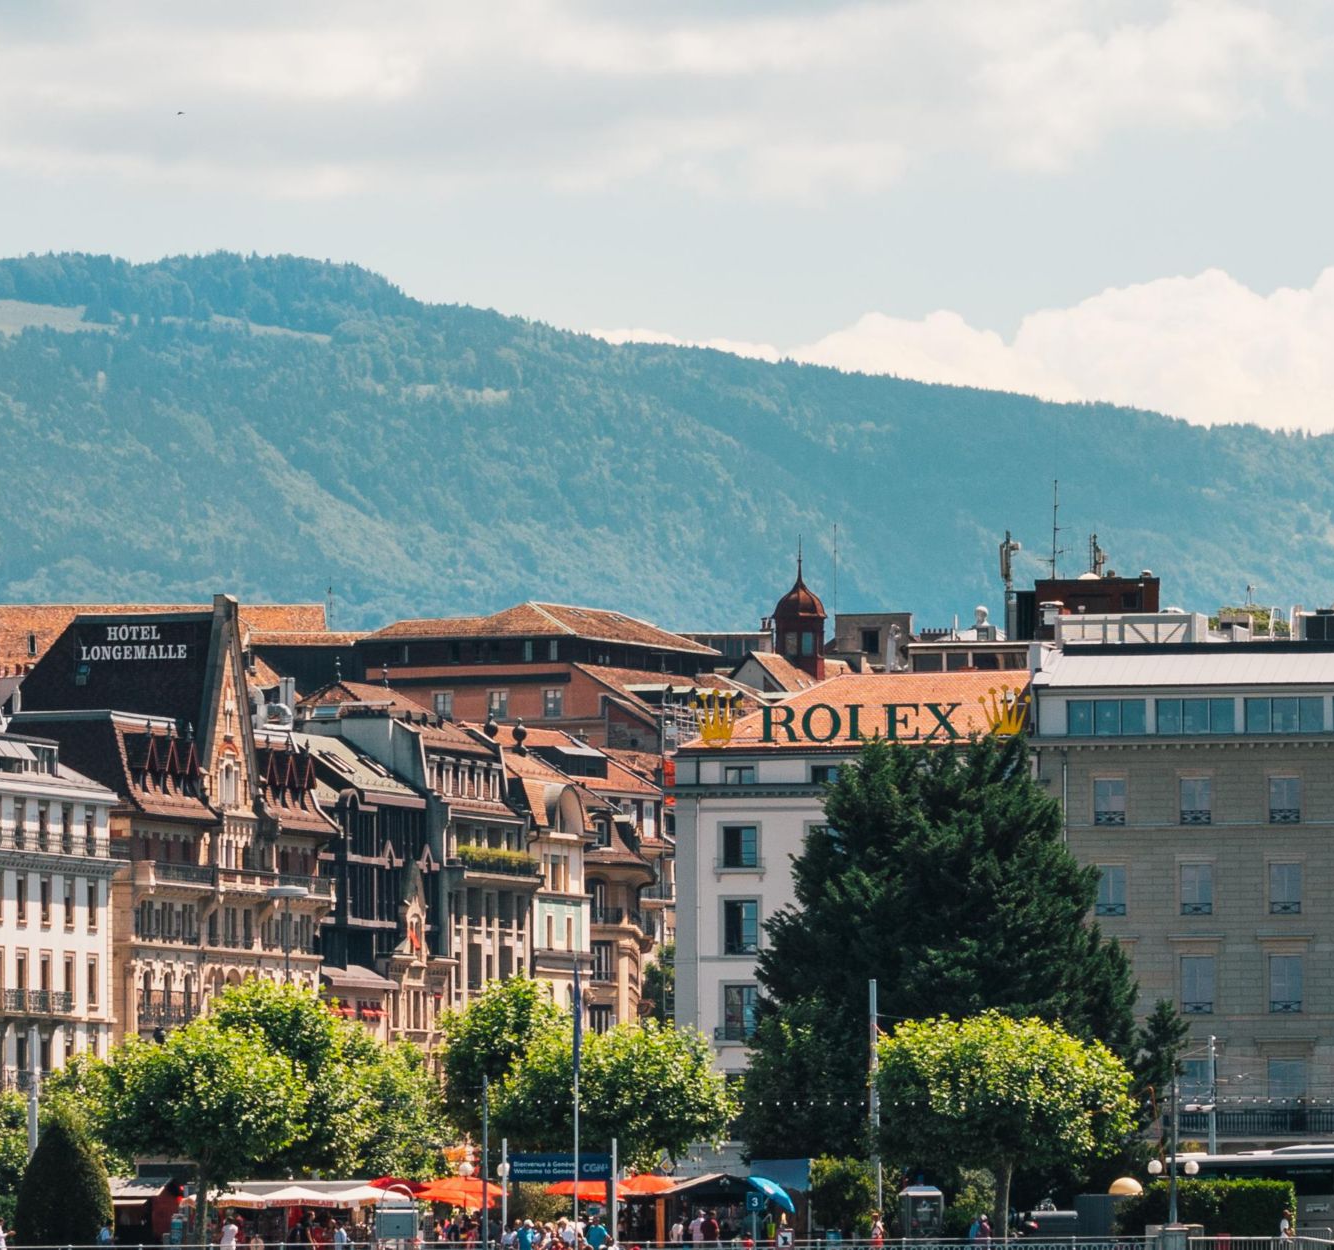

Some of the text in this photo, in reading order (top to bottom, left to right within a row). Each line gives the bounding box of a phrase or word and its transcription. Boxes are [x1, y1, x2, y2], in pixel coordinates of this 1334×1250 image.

[106, 625, 161, 641] HÔTEL
[81, 644, 187, 661] LONGEMALLE
[758, 702, 966, 744] ROLEX
[751, 1197, 759, 1207] 3
